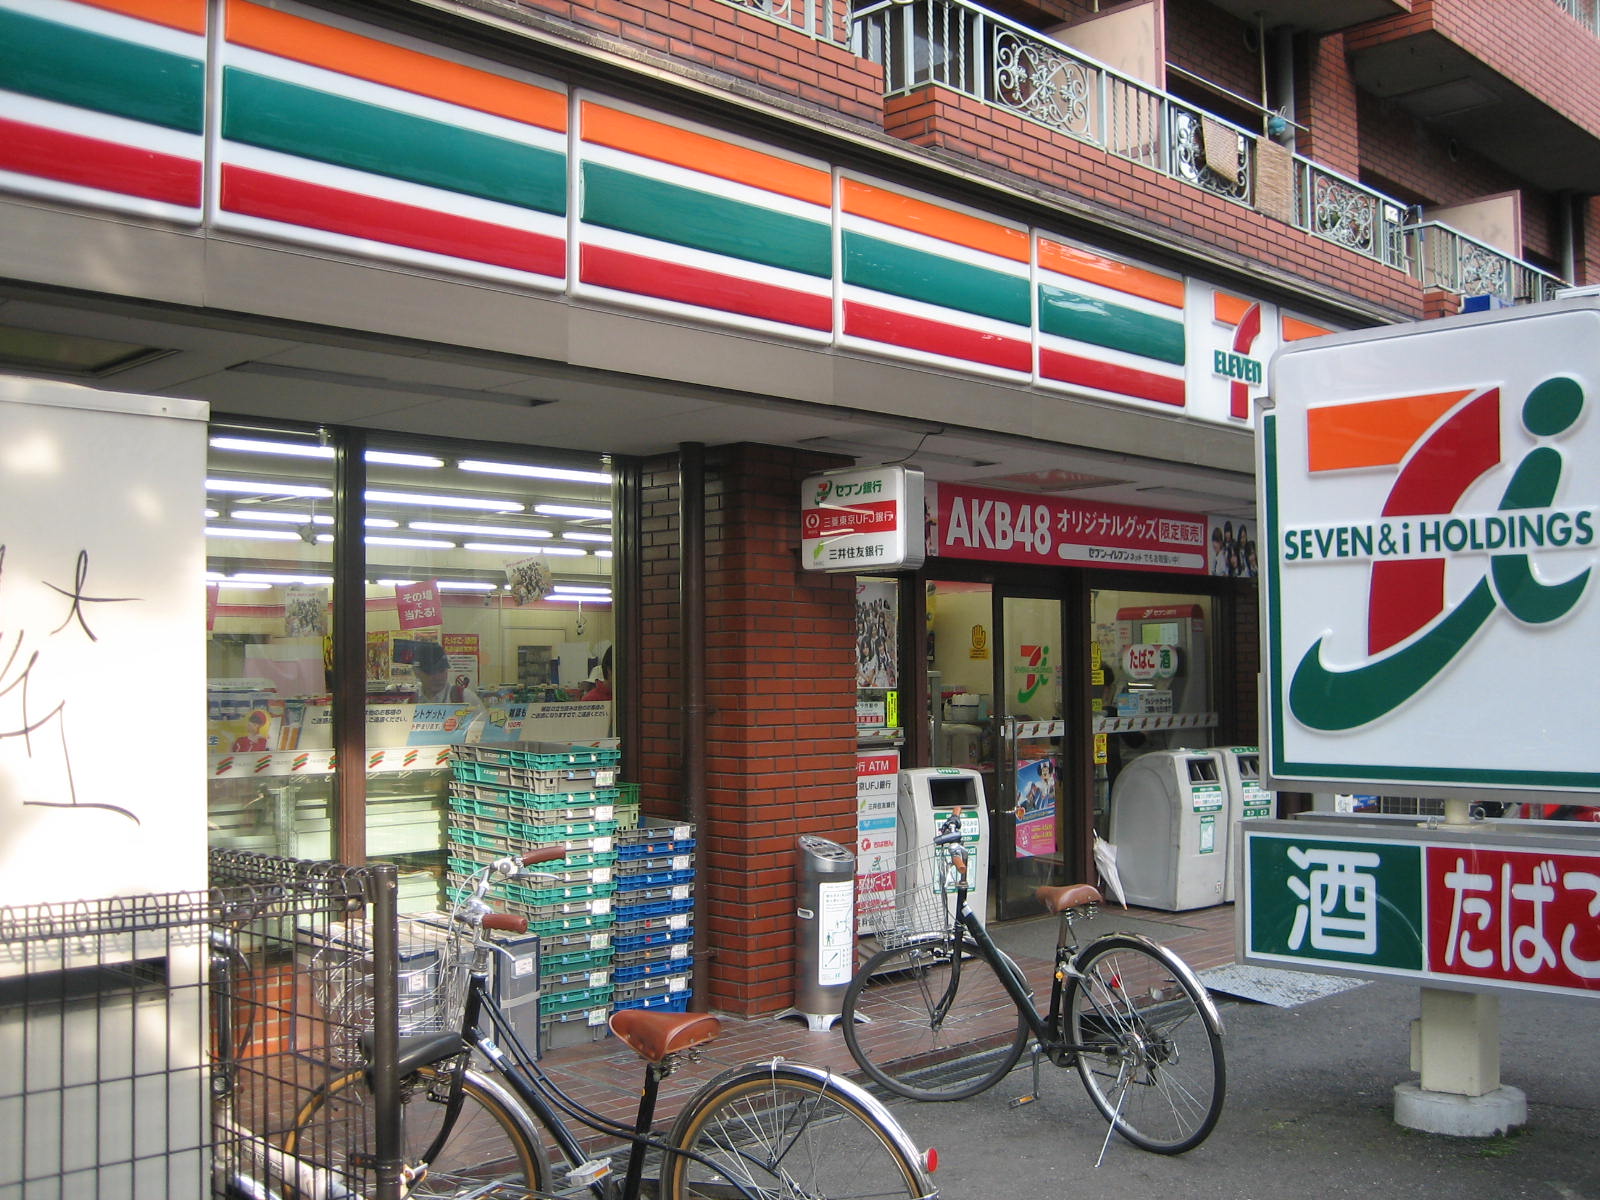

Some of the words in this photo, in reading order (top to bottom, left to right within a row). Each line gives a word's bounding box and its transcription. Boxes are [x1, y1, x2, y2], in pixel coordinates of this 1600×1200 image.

[836, 480, 882, 497] セブン銀行
[946, 497, 1051, 555] AKB48
[1057, 509, 1157, 540] オリジナルグッズ
[1285, 525, 1373, 560] SEVEN
[1378, 528, 1398, 555] &
[1402, 522, 1410, 554] i
[1420, 510, 1594, 553] HOLDINGS
[829, 544, 884, 560] 三井住友銀行
[403, 590, 433, 603] その場
[405, 607, 436, 621] 当たる!
[1129, 648, 1155, 669] たばこ
[1160, 649, 1171, 668] 酒
[869, 760, 889, 771] ATM
[1287, 846, 1380, 955] 酒
[1444, 857, 1600, 979] たばこ
